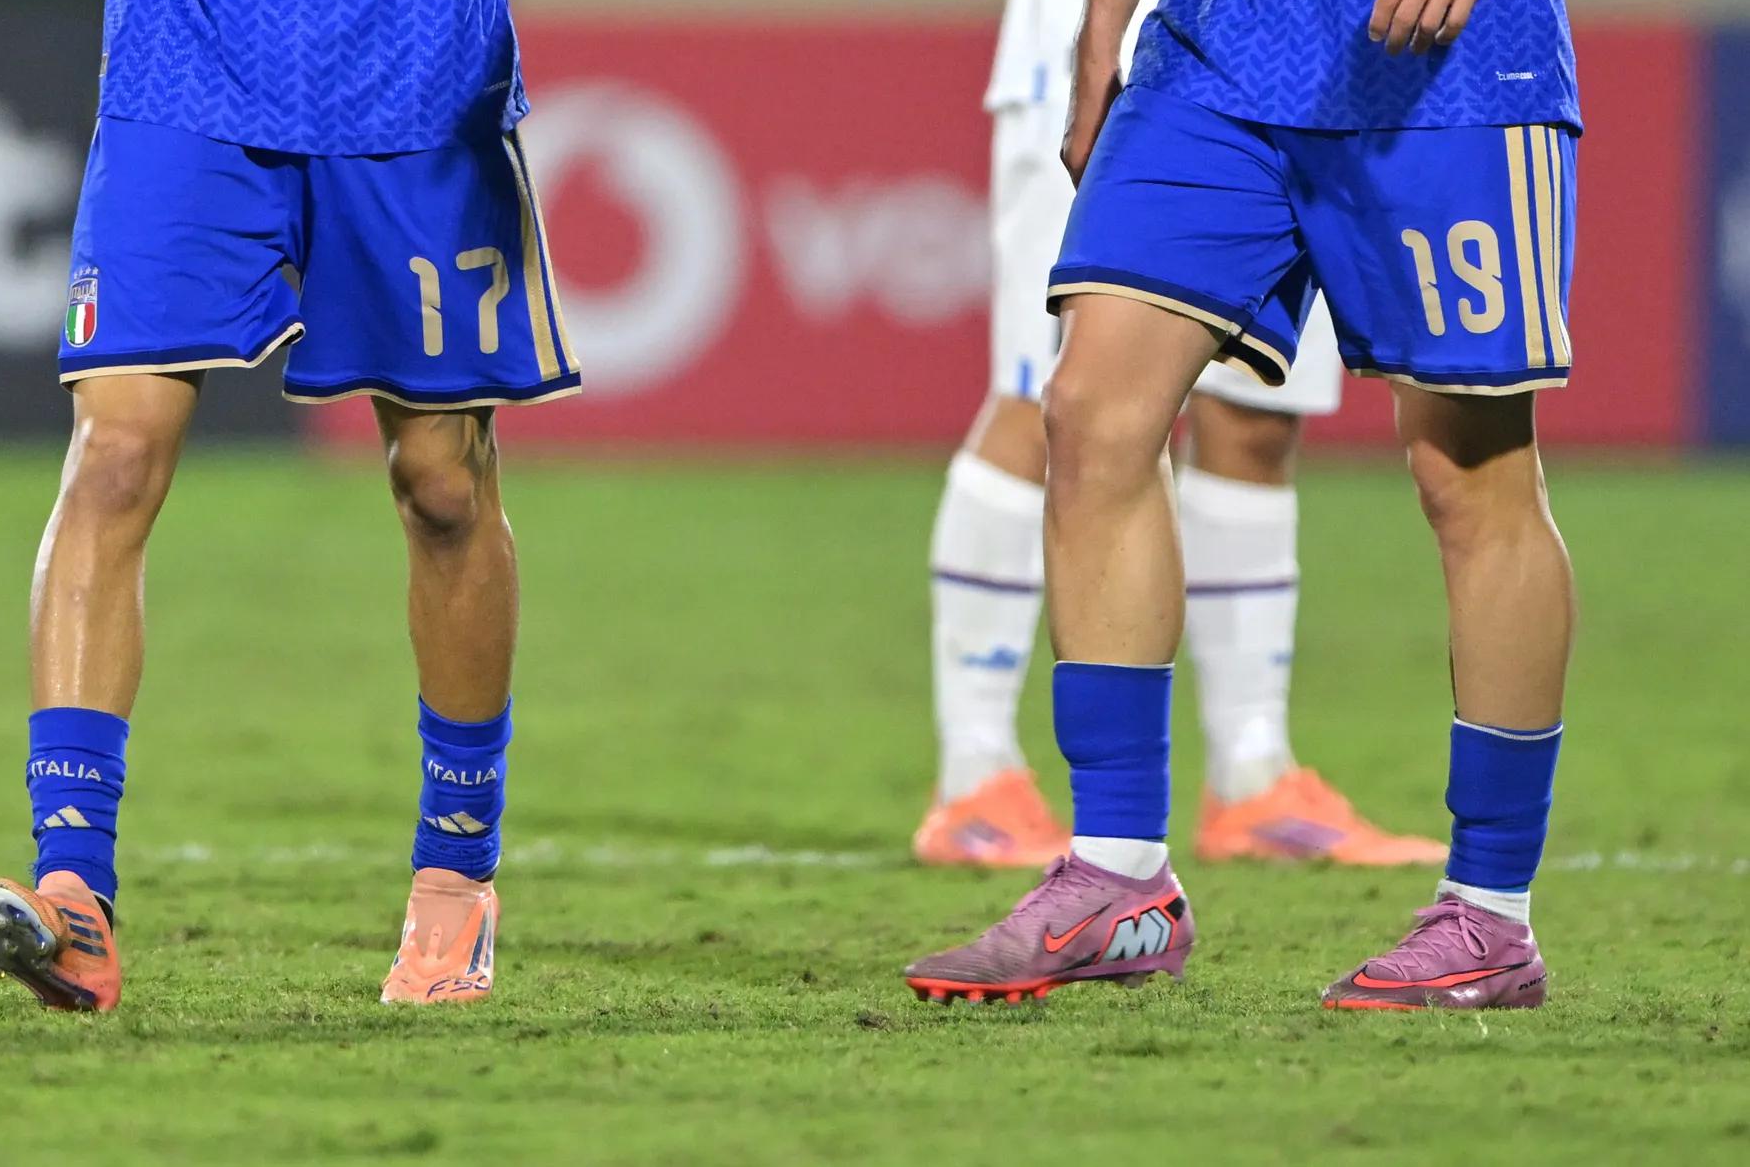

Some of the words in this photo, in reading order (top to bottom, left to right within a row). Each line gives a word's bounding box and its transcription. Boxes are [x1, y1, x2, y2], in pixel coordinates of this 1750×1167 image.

[1402, 220, 1505, 337] 19
[409, 248, 510, 356] 17
[31, 760, 101, 782] ITALIA
[428, 759, 497, 785] ITALIA
[427, 975, 491, 998] F50
